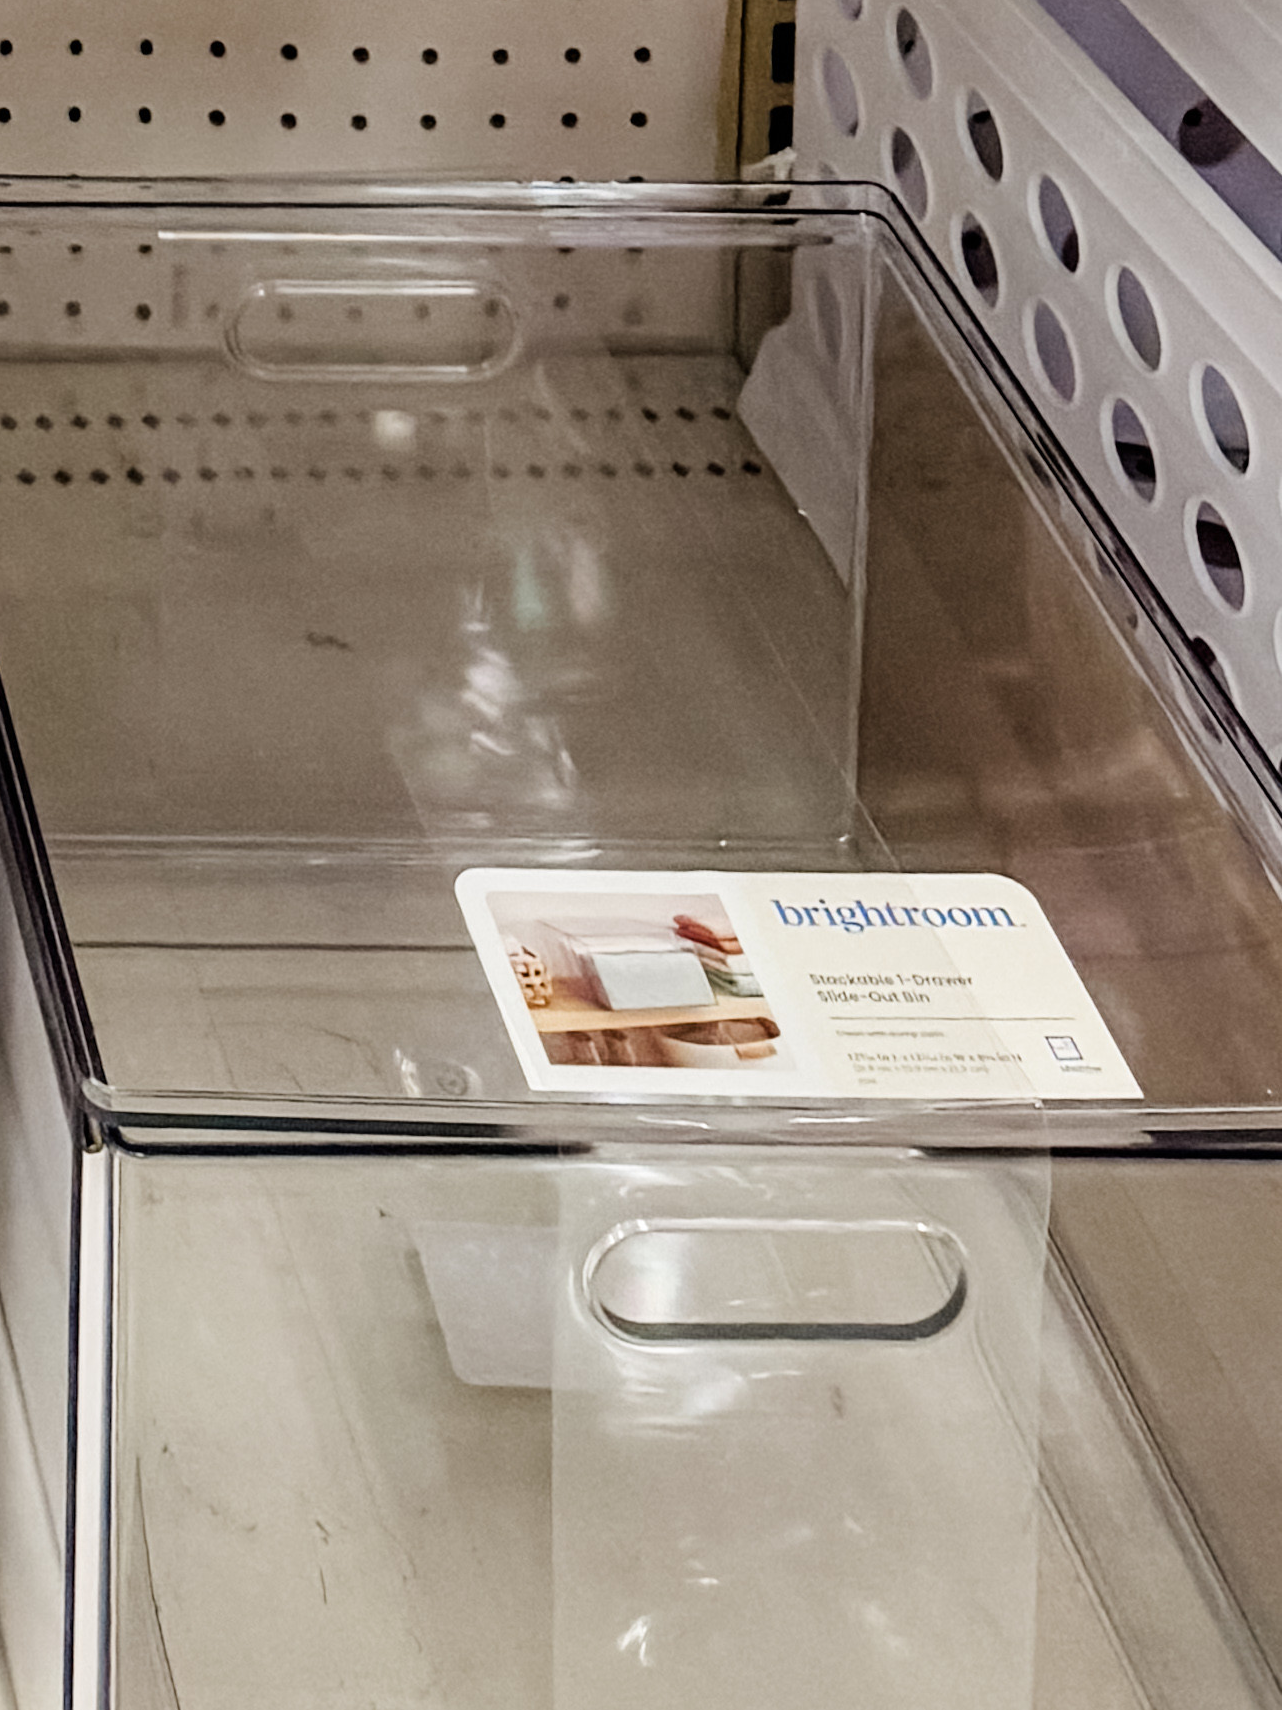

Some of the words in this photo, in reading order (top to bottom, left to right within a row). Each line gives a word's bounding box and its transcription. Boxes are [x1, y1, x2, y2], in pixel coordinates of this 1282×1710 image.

[808, 974, 895, 986] Stackable
[895, 973, 973, 986] 1-Drawer
[816, 990, 901, 1004] Slide-Out
[902, 990, 932, 1004] Bin
